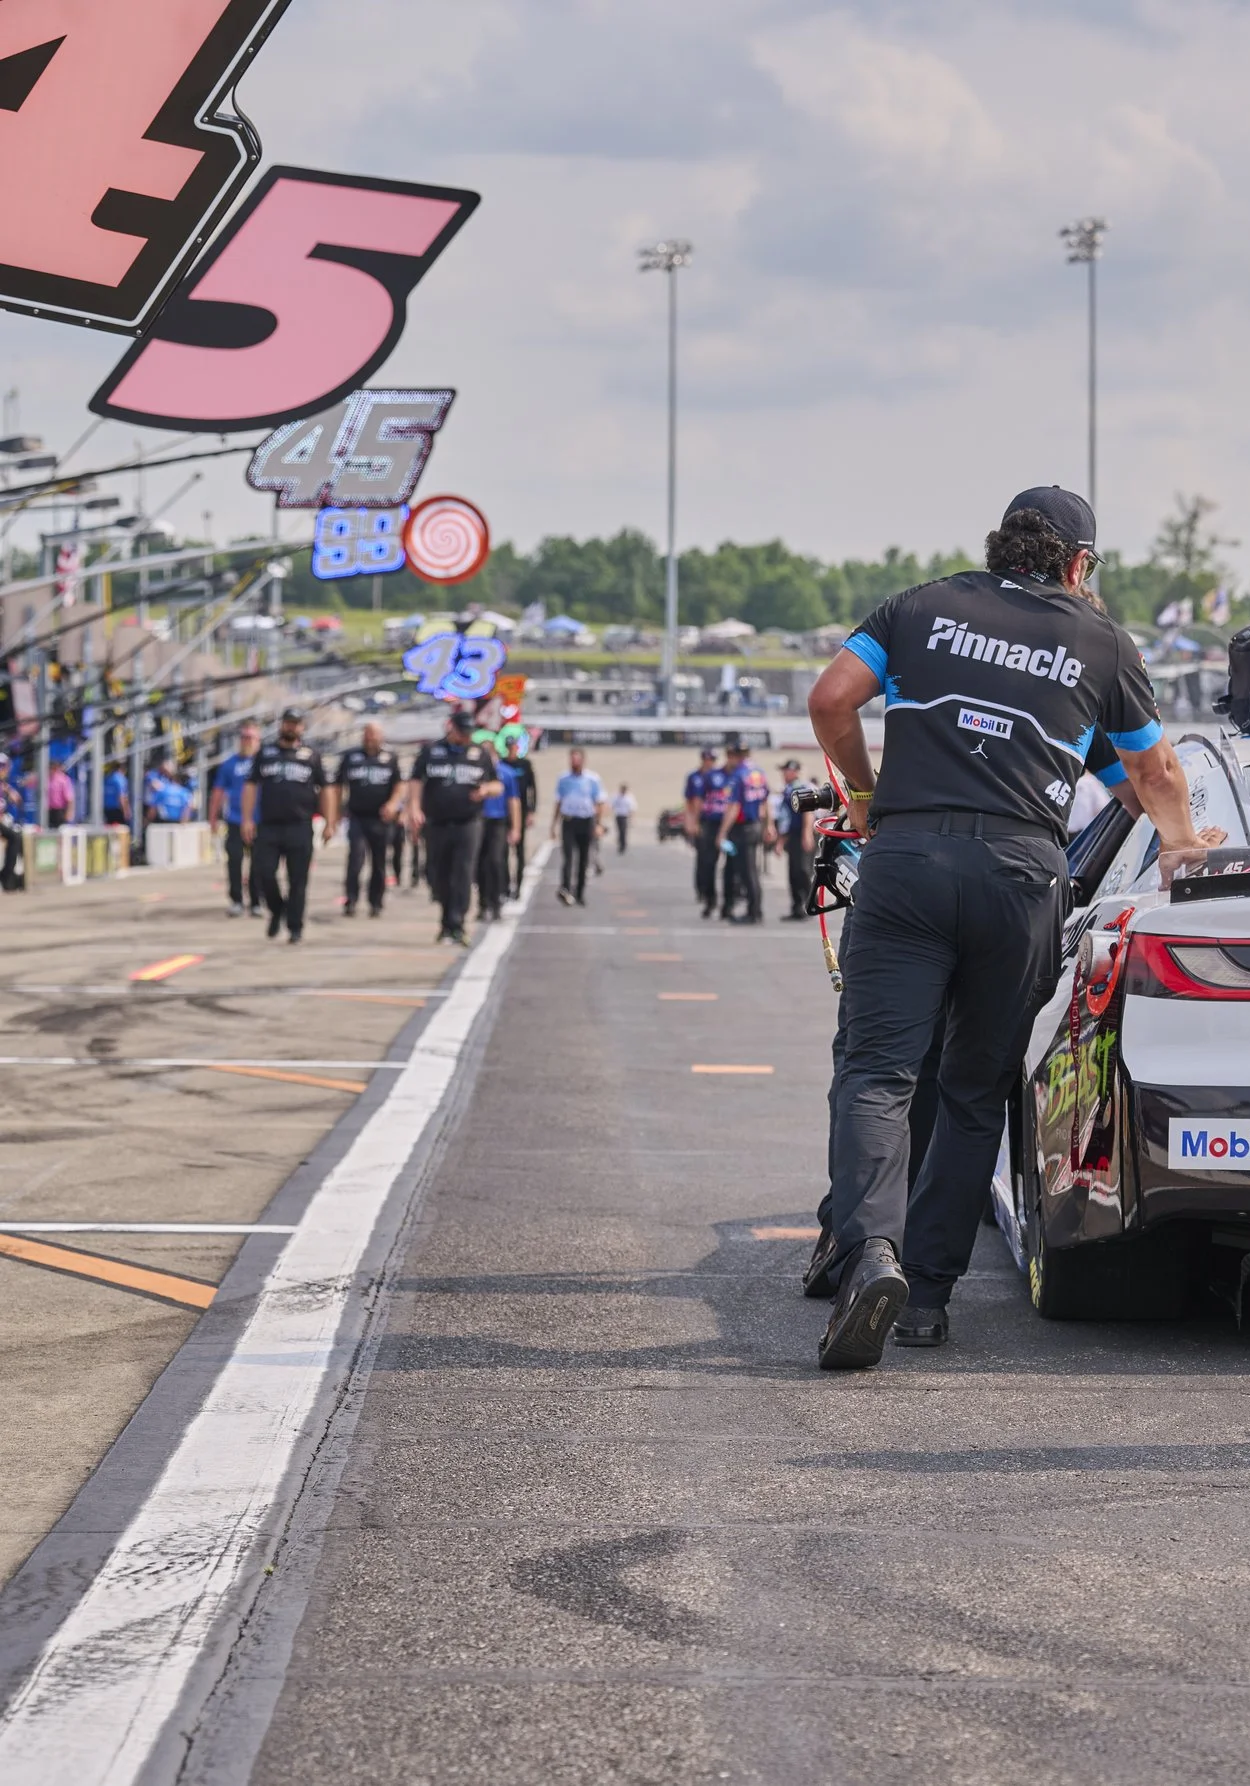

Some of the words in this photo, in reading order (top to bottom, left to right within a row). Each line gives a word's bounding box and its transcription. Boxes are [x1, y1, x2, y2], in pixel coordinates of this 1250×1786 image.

[103, 174, 466, 422] 5
[247, 388, 456, 508] 45
[402, 632, 506, 699] 43
[927, 616, 1084, 688] Pinnacle
[961, 713, 996, 731] Mobil
[1044, 779, 1072, 807] 45
[1222, 861, 1244, 874] 45
